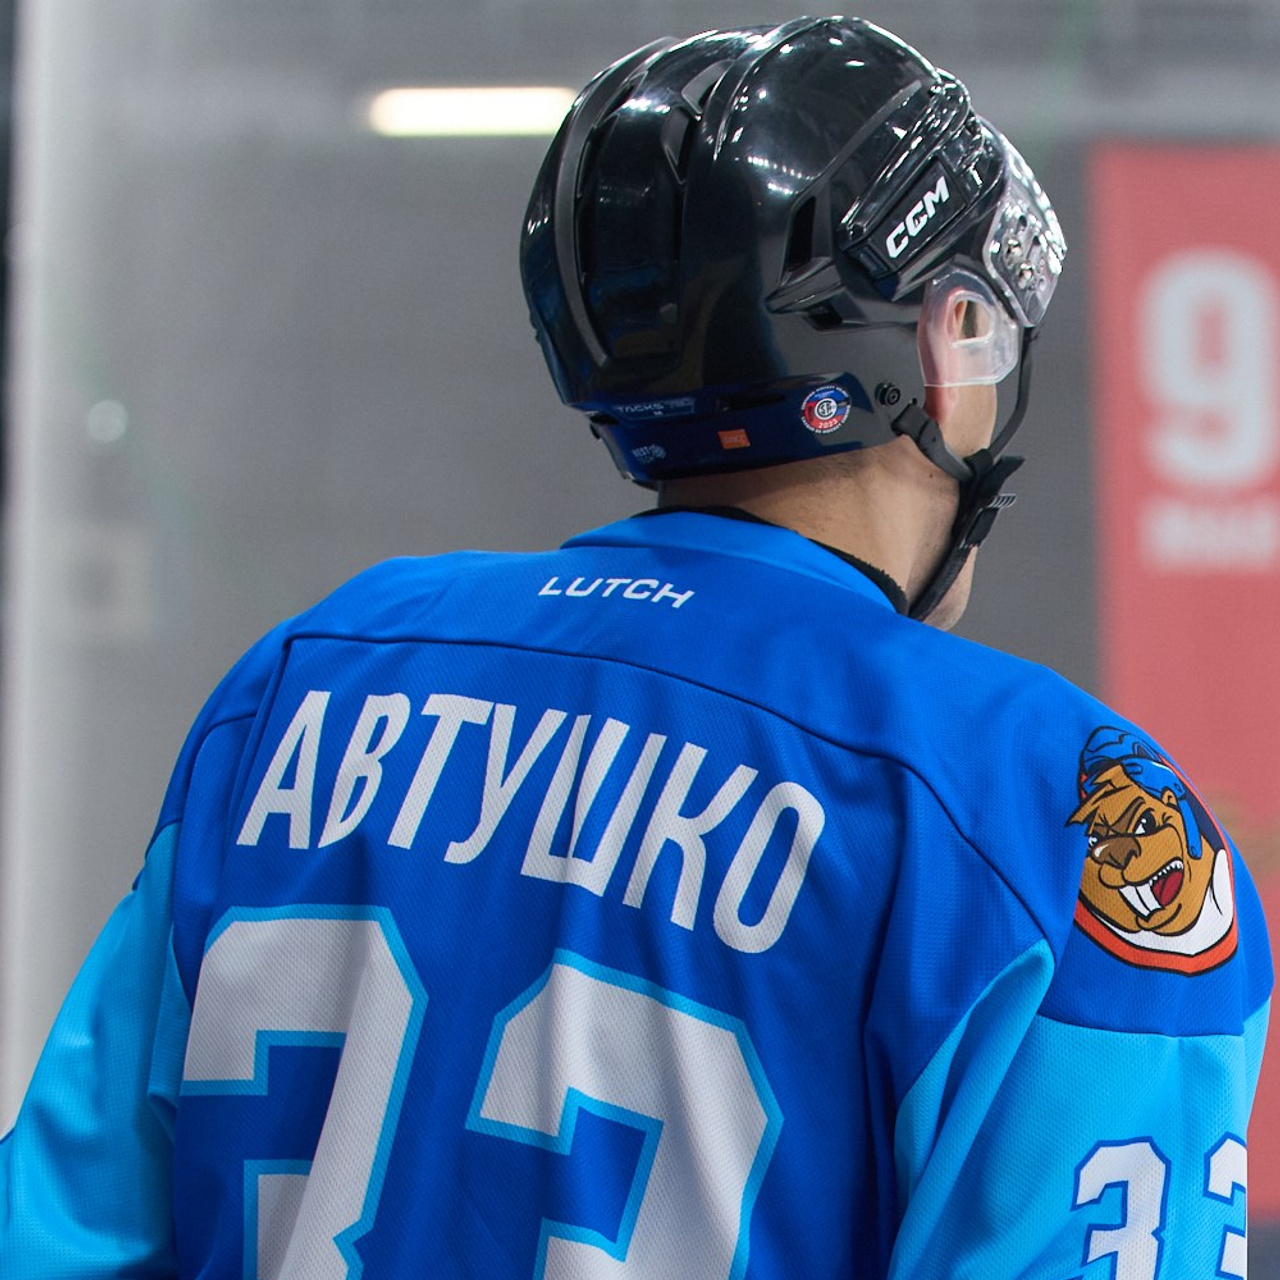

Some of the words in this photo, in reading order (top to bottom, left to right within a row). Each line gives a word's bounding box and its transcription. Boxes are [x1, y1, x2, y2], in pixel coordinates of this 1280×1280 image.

[886, 176, 950, 258] CCM
[538, 576, 696, 609] LUTCH
[236, 689, 826, 954] АВТУШКО
